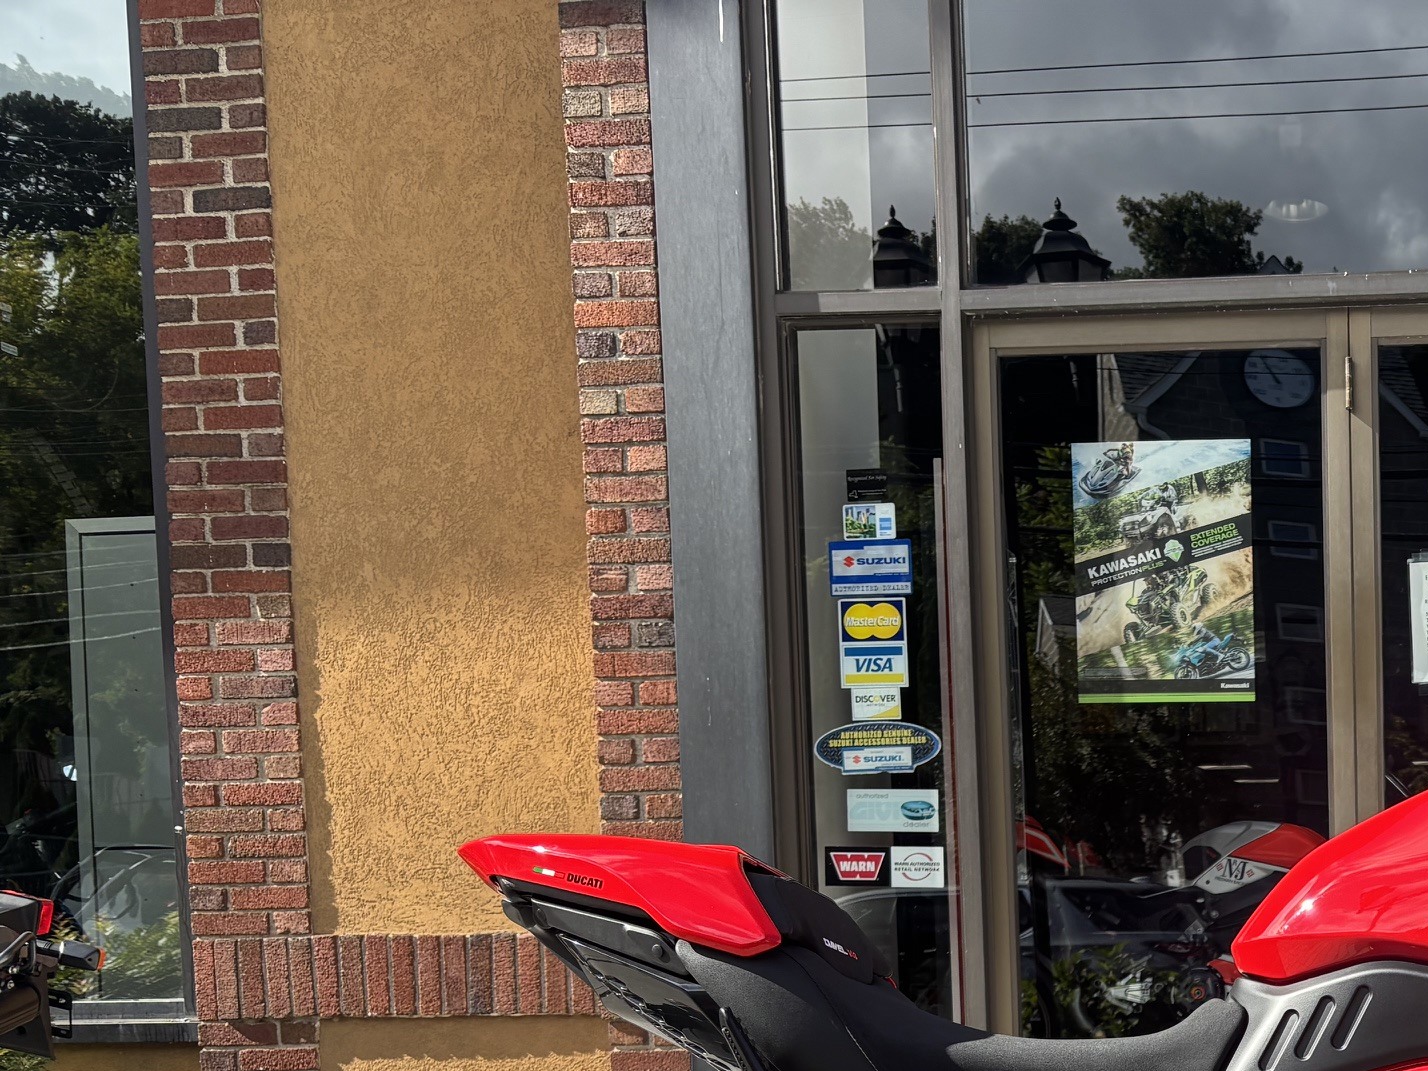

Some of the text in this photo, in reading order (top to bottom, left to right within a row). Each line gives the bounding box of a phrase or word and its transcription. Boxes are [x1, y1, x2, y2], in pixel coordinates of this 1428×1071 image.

[1189, 522, 1236, 541] EXTENDED
[1190, 529, 1240, 549] COVERAGE
[856, 557, 906, 566] SUZUKI
[1087, 547, 1162, 579] KAWASAKI
[834, 583, 911, 593] AUTHORIZED DEALER
[845, 616, 900, 627] MasterCard
[854, 657, 894, 673] VISA
[1220, 681, 1250, 689] Kawasaki
[855, 694, 896, 704] DISCOVER
[840, 729, 912, 739] AUTHORIZED GENUINE
[828, 736, 927, 748] SUZUKI ACCESSORIES DEALER
[863, 755, 902, 763] SUZUKI
[839, 860, 876, 872] WARN
[566, 872, 604, 890] DUCATI
